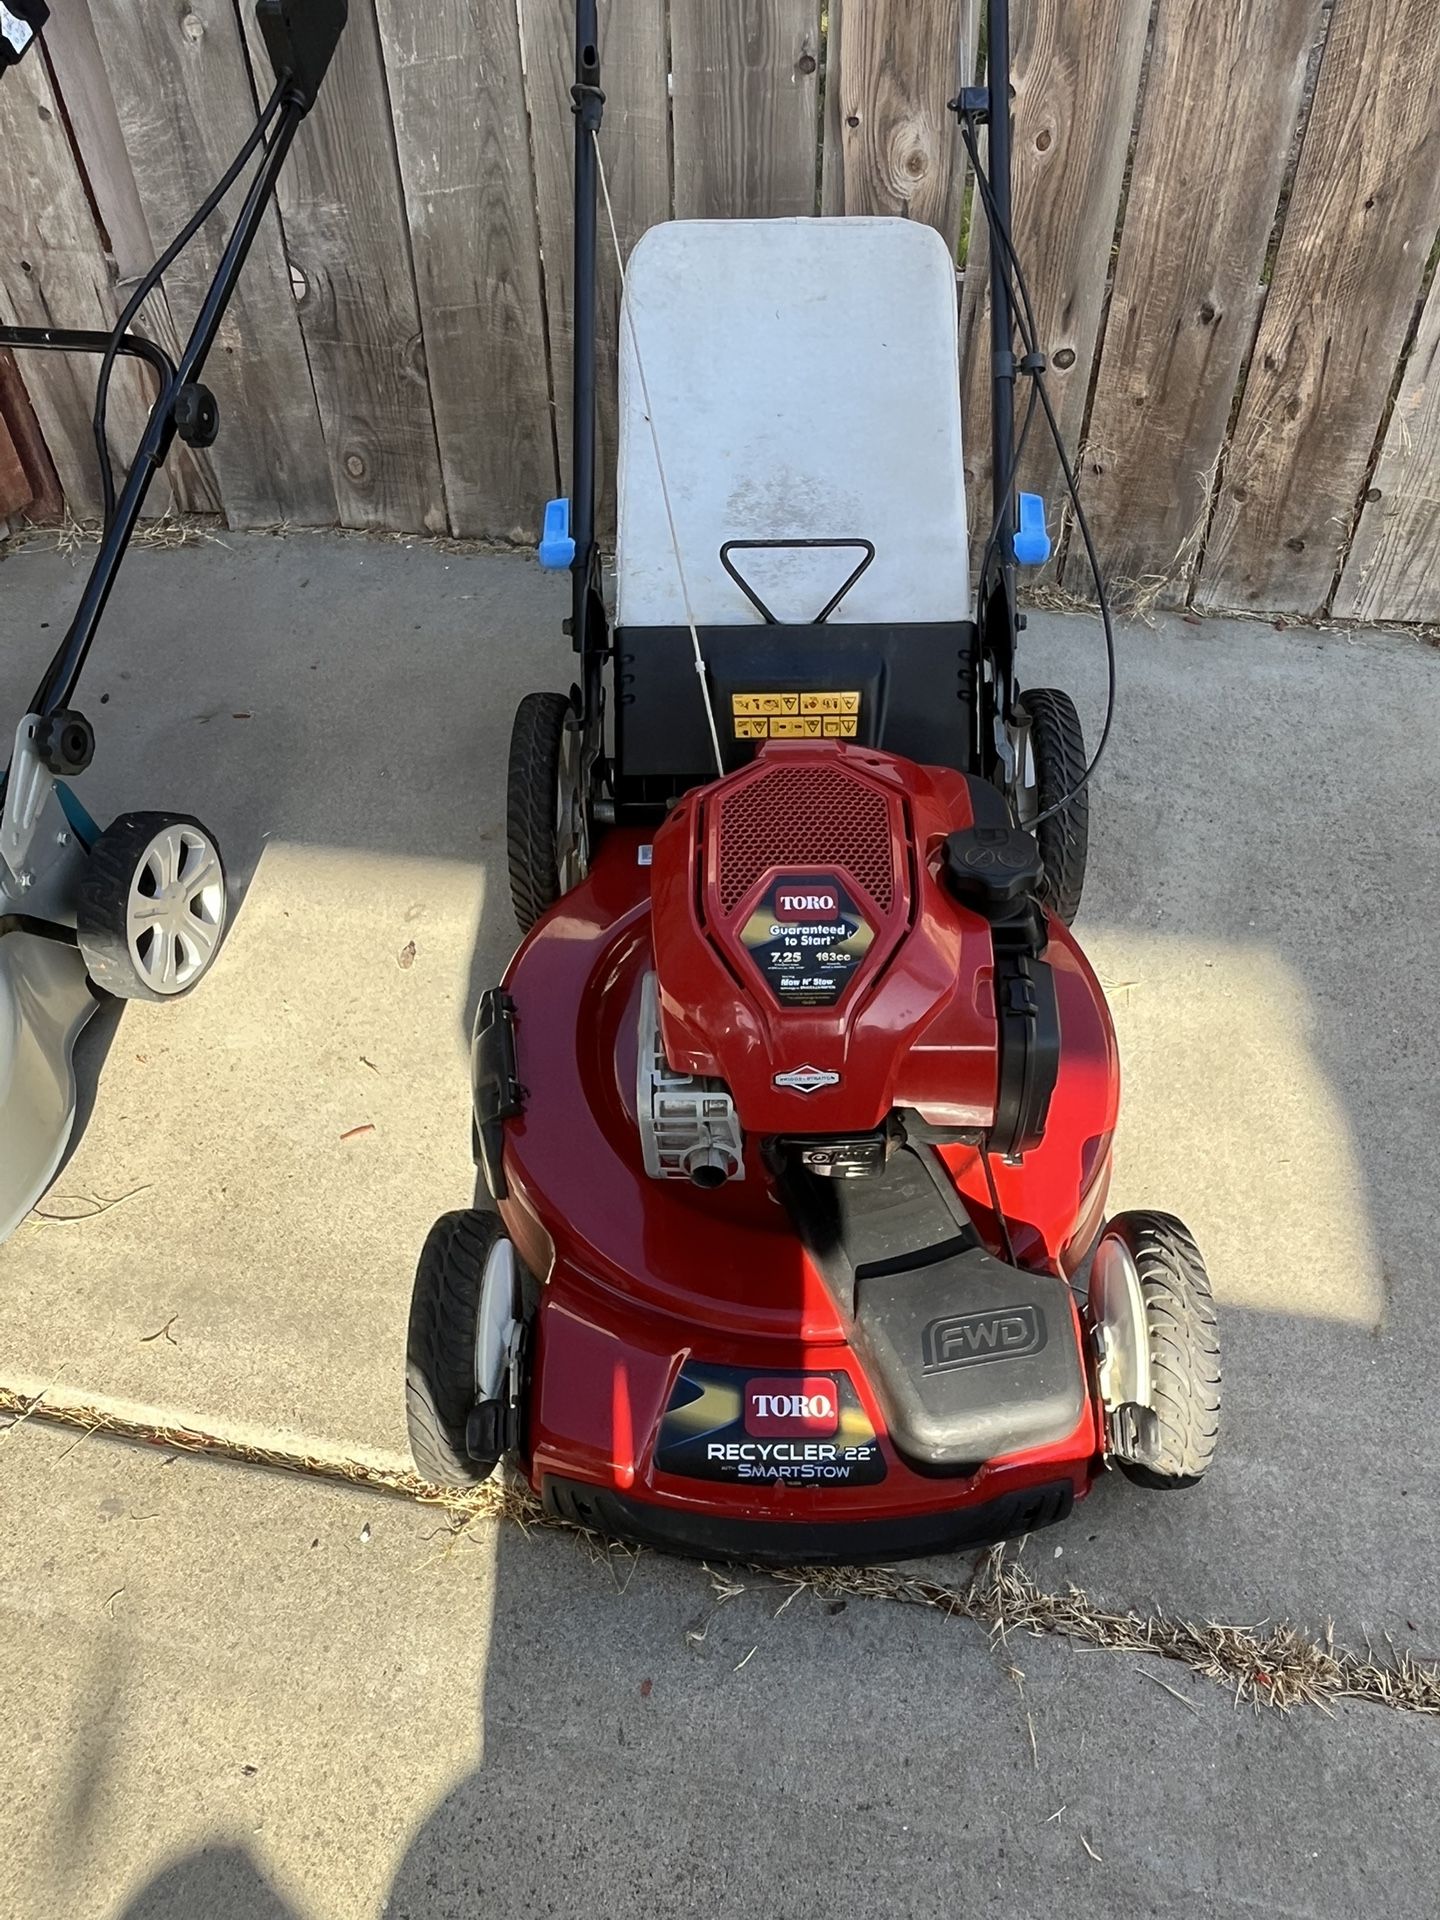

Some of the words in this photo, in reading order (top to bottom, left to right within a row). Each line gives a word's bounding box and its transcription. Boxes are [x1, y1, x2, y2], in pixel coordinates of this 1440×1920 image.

[780, 895, 834, 910] TORO
[769, 924, 845, 936] Guaranteed
[784, 937, 798, 946] to
[770, 952, 802, 963] 7.25
[941, 1317, 1028, 1358] FWD
[752, 1395, 832, 1418] TORO
[707, 1443, 836, 1460] RECYCLER
